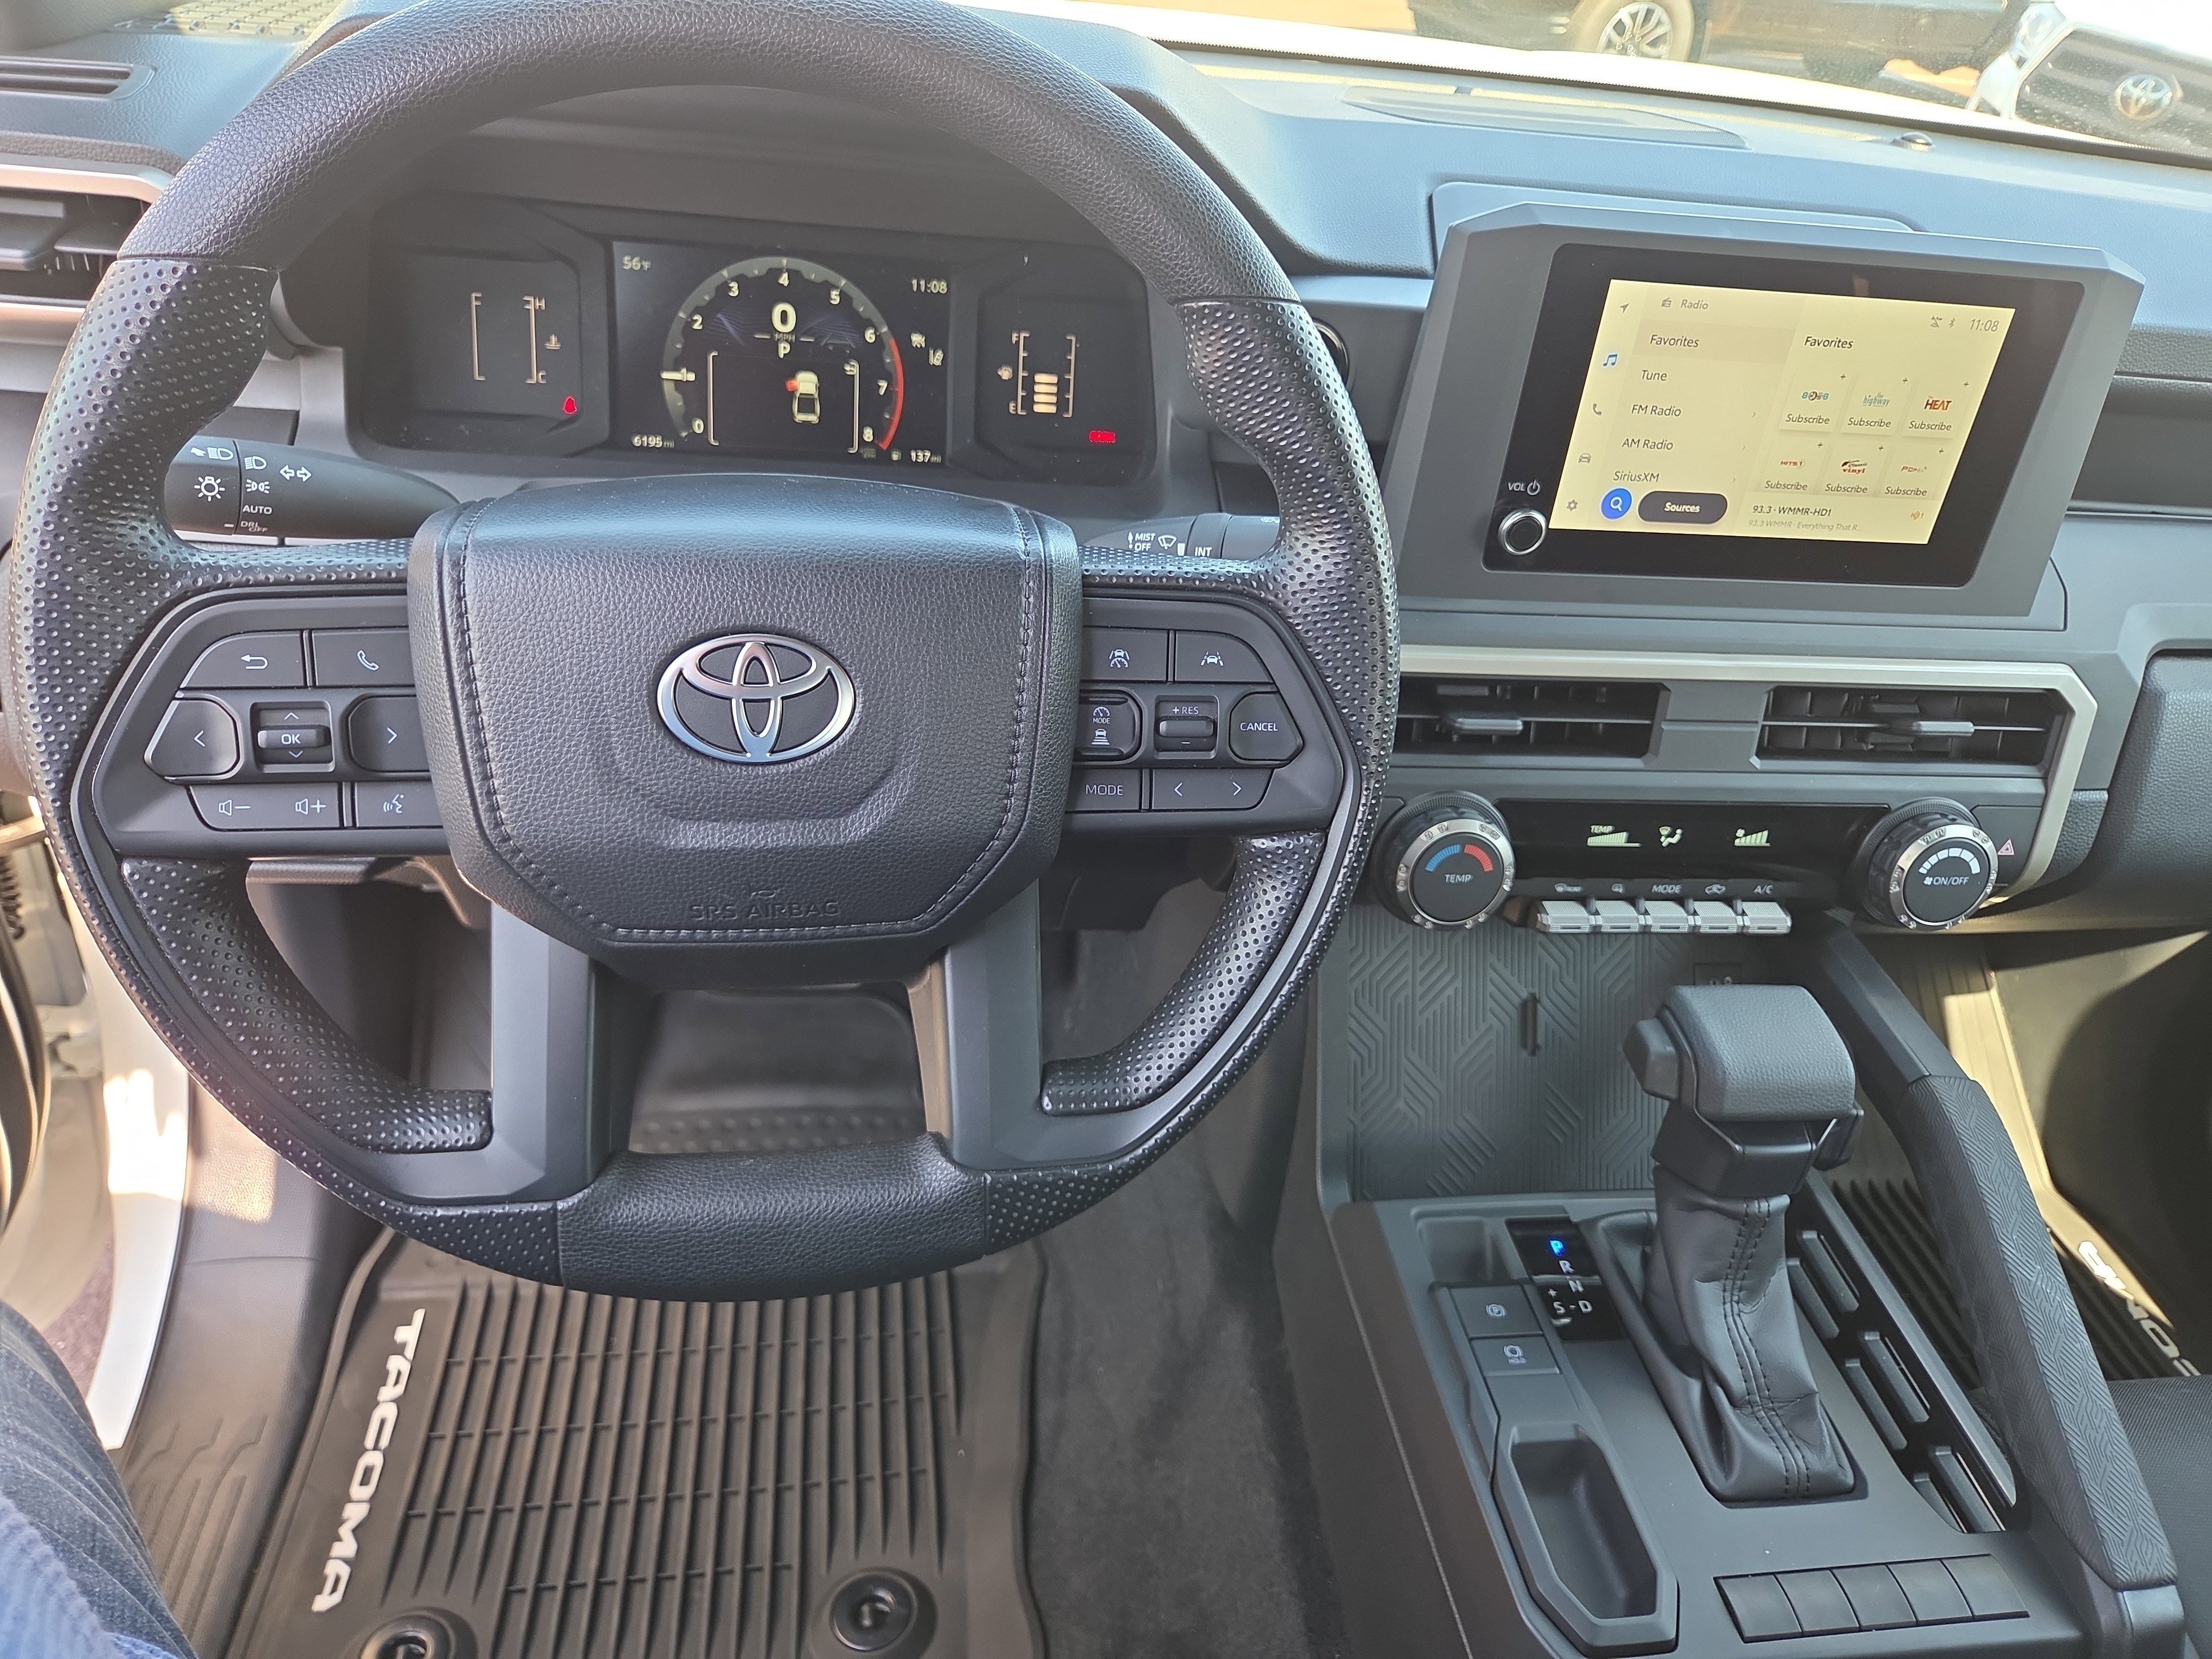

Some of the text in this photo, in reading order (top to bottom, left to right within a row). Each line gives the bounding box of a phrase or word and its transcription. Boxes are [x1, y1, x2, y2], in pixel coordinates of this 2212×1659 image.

[778, 272, 789, 286] 4
[728, 281, 739, 297] 3
[911, 278, 948, 294] 11:08
[829, 288, 840, 304] 5
[1680, 299, 1708, 310] Radio
[692, 314, 703, 330] 2
[771, 302, 796, 333] 0
[1970, 318, 1999, 332] 11:08
[864, 326, 876, 343] 6
[1650, 335, 1700, 348] Favorites
[1804, 336, 1854, 350] Favorites
[778, 341, 790, 358] P
[1641, 370, 1667, 381] Tune
[877, 380, 888, 395] 7
[1863, 395, 1891, 407] highway
[1924, 400, 1952, 410] HEAT
[1631, 404, 1681, 417] FM Radio
[1786, 414, 1830, 425] Subscribe
[1847, 417, 1892, 428] Subscribe
[1908, 420, 1952, 431] Subscribe
[692, 418, 704, 434] 0
[863, 426, 873, 442] 8
[1622, 438, 1673, 450] AM Radio
[1613, 471, 1660, 483] SiriusXM
[1508, 482, 1525, 491] VOL
[1764, 480, 1808, 491] Subscribe
[1825, 483, 1868, 493] Subscribe
[1885, 486, 1927, 496] Subscribe
[242, 505, 272, 515] AUTO
[1664, 501, 1701, 513] Sources
[1752, 505, 1831, 517] 93.3 WMMR-HD1
[1797, 522, 1834, 531] Everything
[1135, 533, 1156, 542] MIST
[1135, 543, 1151, 551] OFF
[1194, 546, 1212, 557] INT
[1240, 722, 1278, 731] CANCEL
[281, 734, 301, 744] OK
[1085, 784, 1123, 796] MODE
[1445, 874, 1472, 883] TEMP
[1933, 876, 1969, 885] ON/OFF
[1652, 885, 1681, 893] MODE
[1753, 884, 1773, 894] A/C
[691, 902, 839, 921] SRS AIRBAG
[1549, 1239, 1564, 1256] P
[1559, 1260, 1574, 1274] R
[1568, 1280, 1584, 1293] N
[1553, 1301, 1592, 1314] S D
[311, 1308, 426, 1612] TACOMA
